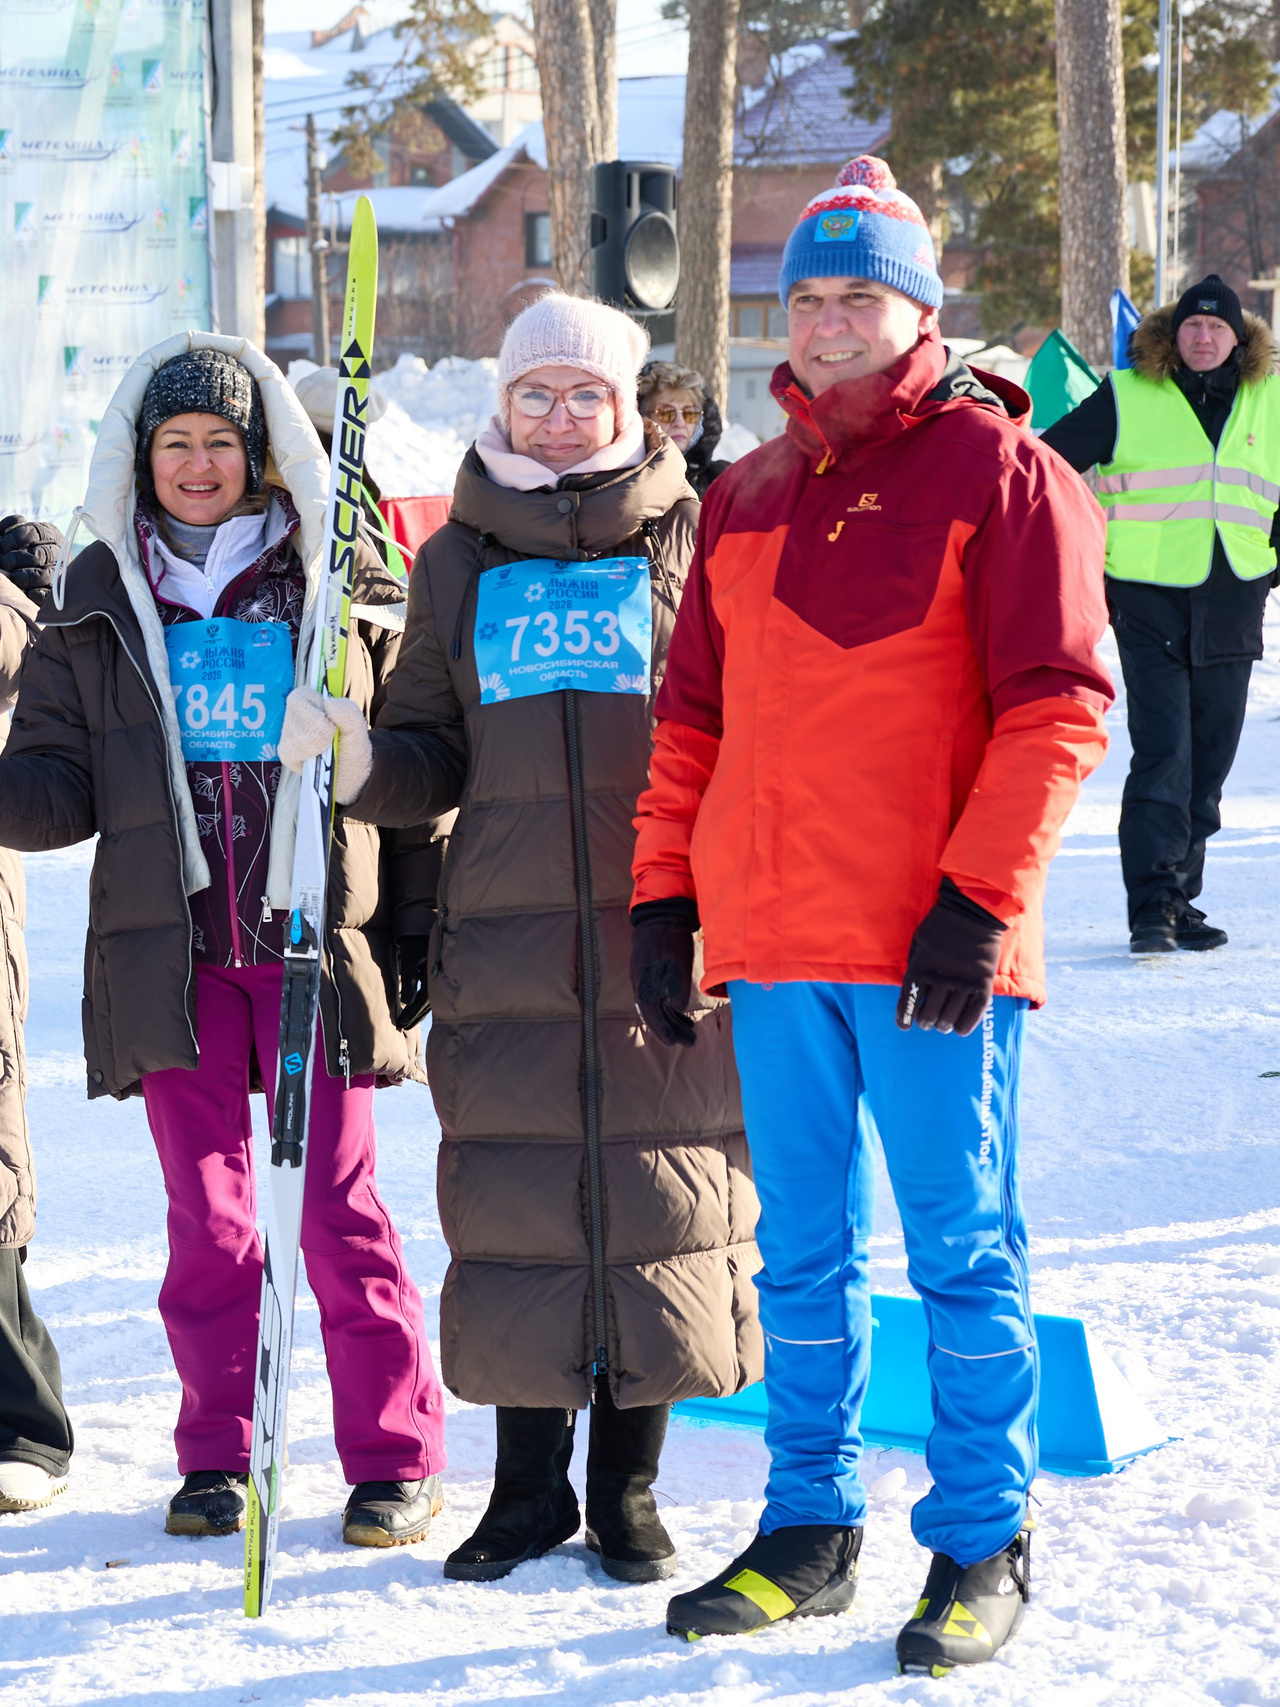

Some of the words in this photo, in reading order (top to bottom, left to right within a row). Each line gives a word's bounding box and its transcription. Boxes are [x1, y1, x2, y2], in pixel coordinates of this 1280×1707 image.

[547, 577, 599, 590] ЛЫЖНЯ
[546, 587, 599, 600] РОССИИ
[548, 599, 573, 610] 2026
[505, 610, 620, 662] 7353
[203, 646, 245, 659] ЛЫЖНЯ
[202, 657, 245, 670] РОССИИ
[509, 659, 619, 676] НОВОСИБИРСКАЯ
[539, 670, 588, 682] ОБЛАСТЬ
[189, 741, 236, 749] ОБЛАСТЬ
[903, 981, 920, 1026] SWIX
